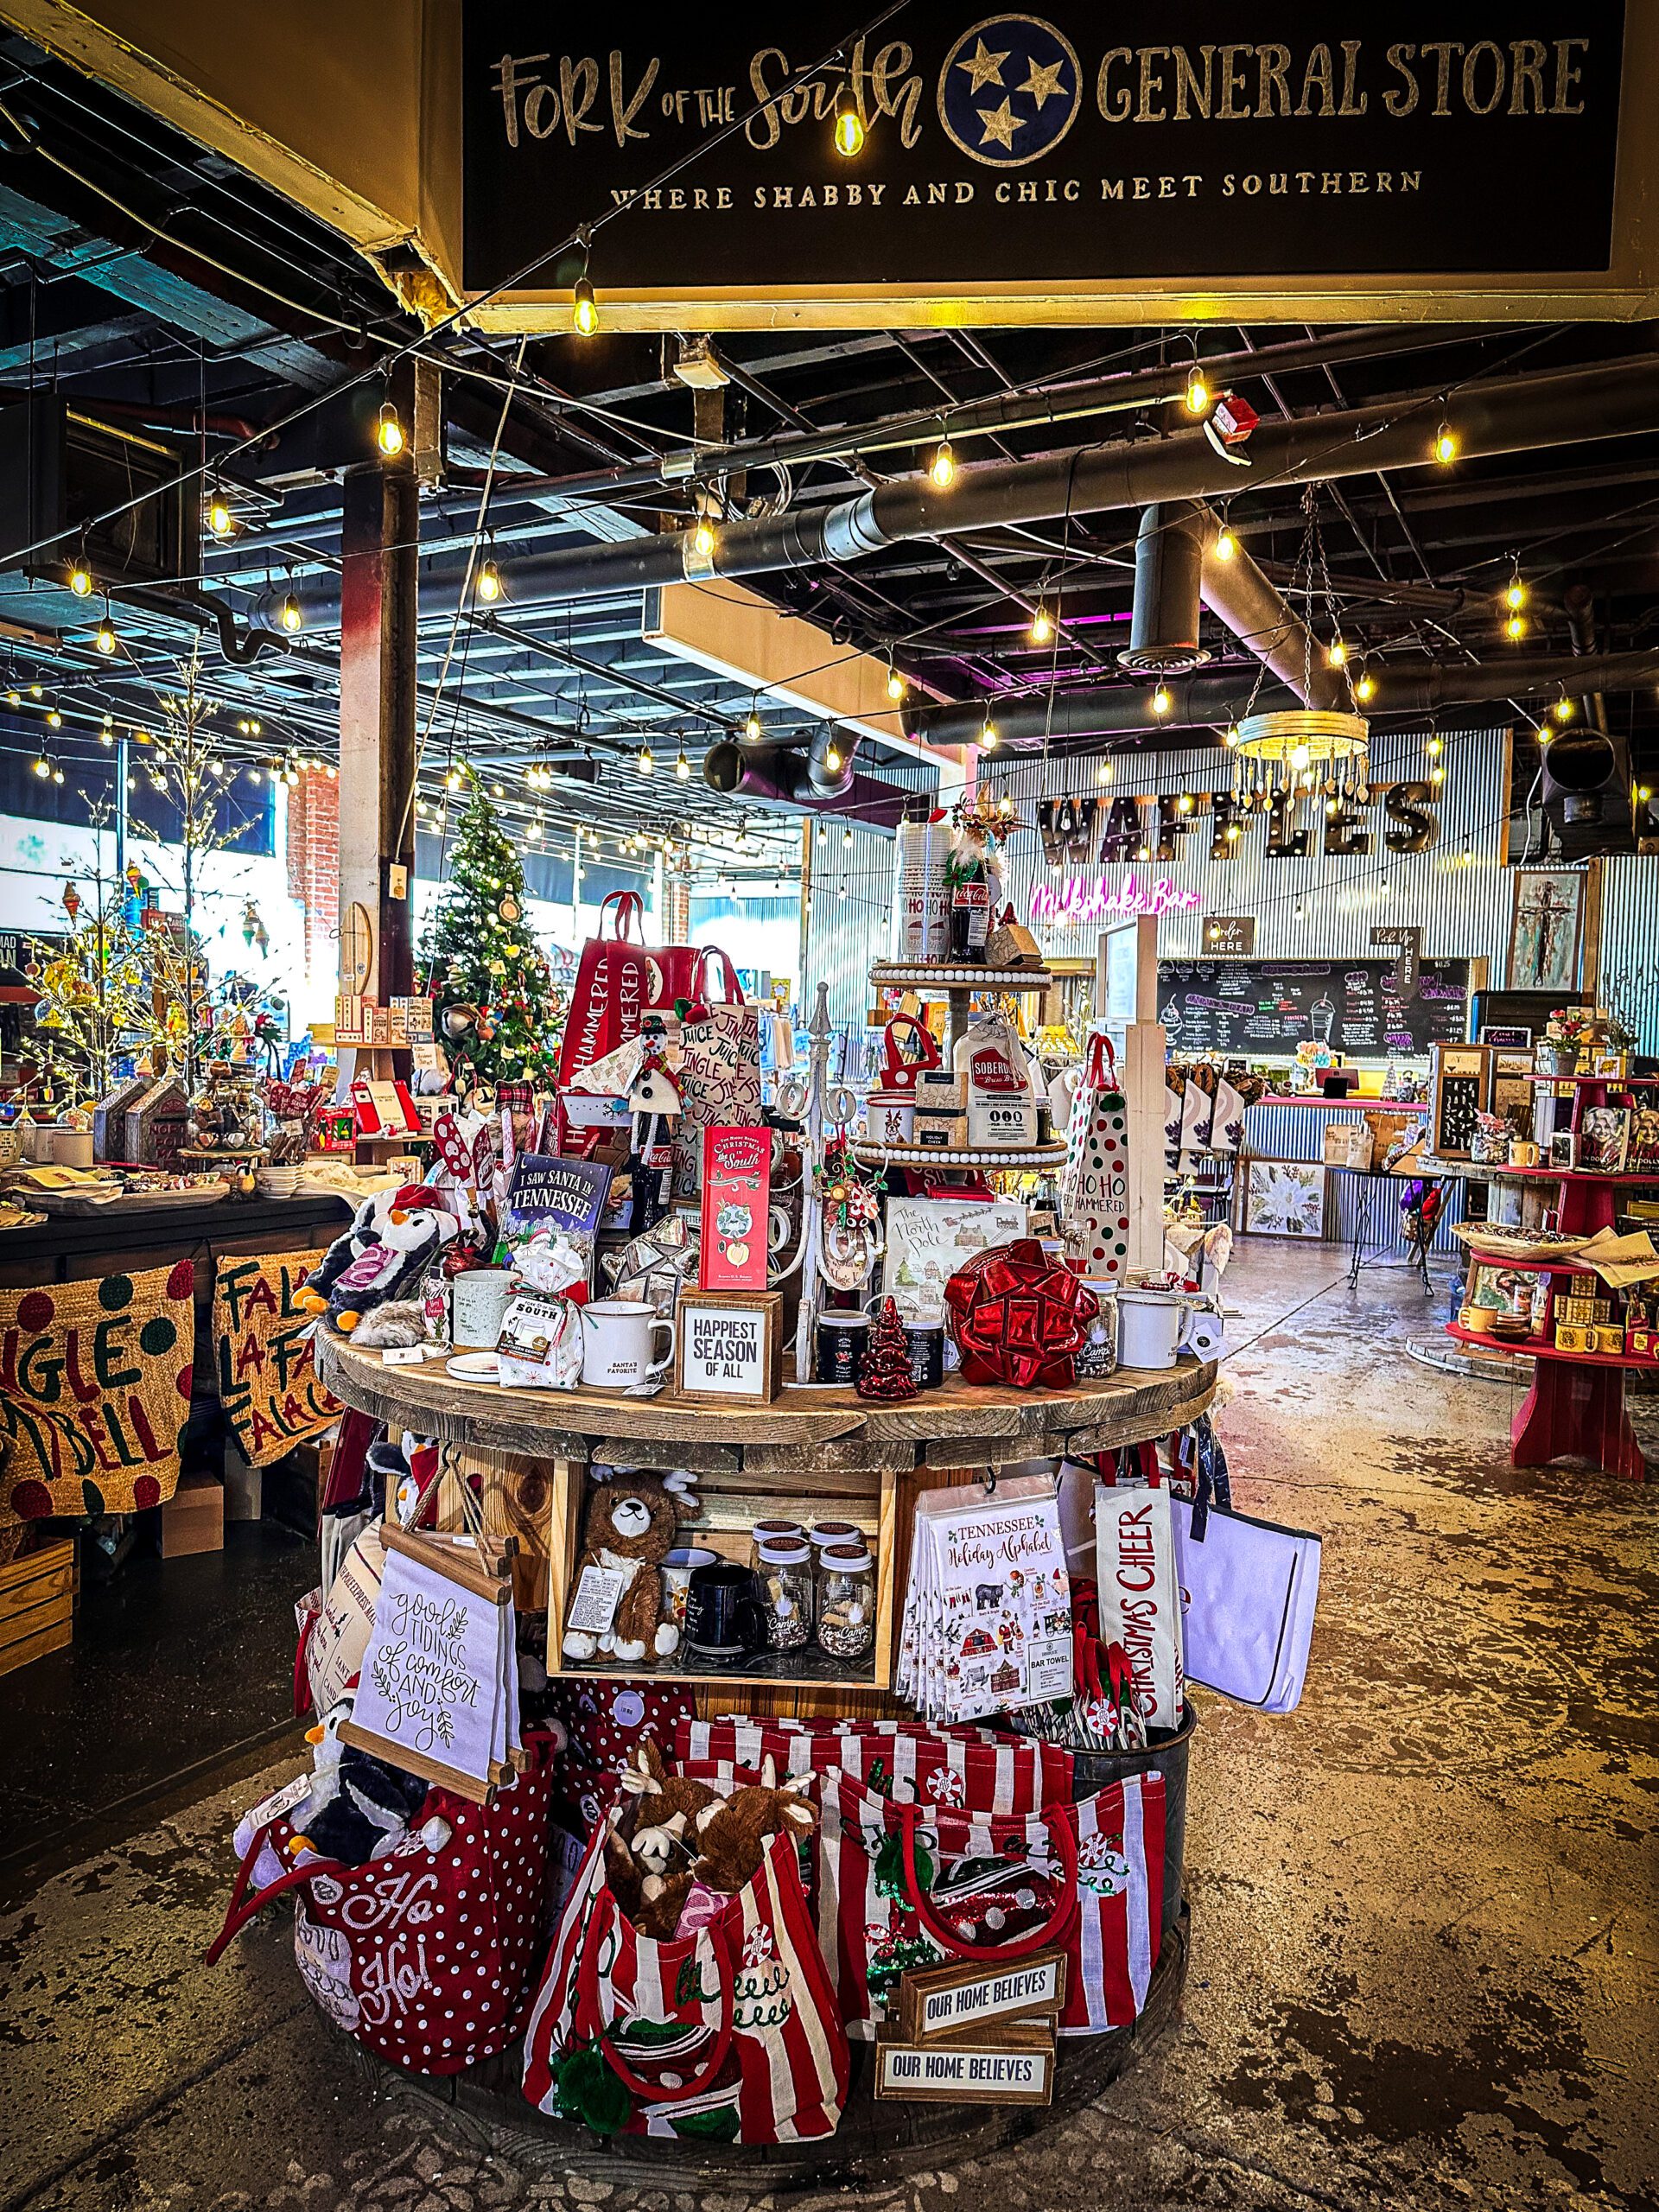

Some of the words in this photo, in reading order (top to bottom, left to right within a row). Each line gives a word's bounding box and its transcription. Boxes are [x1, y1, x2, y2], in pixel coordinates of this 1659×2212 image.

[489, 49, 660, 148] FORK
[662, 89, 690, 125] OF
[692, 86, 735, 129] THE
[745, 38, 923, 149] South
[1096, 40, 1368, 123] GENERAL
[1382, 38, 1590, 118] STORE
[611, 188, 734, 211] WHERE
[754, 183, 884, 208] SHABBY
[903, 181, 975, 205] AND
[995, 179, 1081, 203] CHIC
[1102, 175, 1203, 200] MEET
[1223, 171, 1422, 197] SOUTHERN
[1038, 779, 1441, 865] WAFFLES
[908, 899, 925, 914] HO
[1147, 876, 1201, 916] Bar
[1211, 942, 1243, 951] HERE
[1399, 929, 1414, 946] Up
[1404, 948, 1414, 984] HERE
[682, 1047, 723, 1081] JINGLE
[709, 1036, 738, 1068] JuiC
[714, 1141, 766, 1155] CHRISTMAS
[724, 1152, 761, 1170] South
[519, 1175, 524, 1187] I
[526, 1171, 544, 1185] SAW
[547, 1169, 582, 1192] SANTA
[582, 1180, 594, 1195] IN
[1099, 1175, 1126, 1198] HO
[512, 1188, 593, 1223] TENNESSEE
[893, 1206, 921, 1222] The
[1075, 1198, 1125, 1213] HAMMERED
[892, 1216, 940, 1241] North
[908, 1232, 949, 1259] Pole
[516, 1303, 558, 1320] SOUTH
[694, 1319, 758, 1340] HAPPIEST
[693, 1338, 758, 1363] SEASON
[1082, 1344, 1110, 1359] Camp
[705, 1362, 719, 1376] OF
[722, 1363, 744, 1379] ALL
[957, 1516, 1036, 1541] TENNESSEE
[947, 1541, 995, 1570] Holiday
[996, 1530, 1052, 1562] Alphabet
[1116, 1503, 1156, 1592] CHEER
[350, 1581, 370, 1611] EXPRESS
[389, 1593, 457, 1636] good
[768, 1617, 798, 1633] Camp
[410, 1618, 467, 1670] TIDINGS
[838, 1625, 868, 1640] Camp
[1031, 1659, 1045, 1669] BAR
[1046, 1656, 1070, 1666] TOWEL
[1120, 1598, 1159, 1719] CHRISTMAS
[378, 1641, 408, 1682] of
[405, 1652, 481, 1708] comfort
[323, 1677, 339, 1700] CAND
[398, 1674, 436, 1706] AND
[342, 1871, 439, 1929] Ho
[926, 1994, 953, 2020] OUR
[956, 1986, 990, 2012] HOME
[993, 1969, 1046, 2004] BELIEVES
[893, 2055, 921, 2078] OUR
[925, 2056, 964, 2080] HOME
[969, 2056, 1033, 2082] BELIEVES
